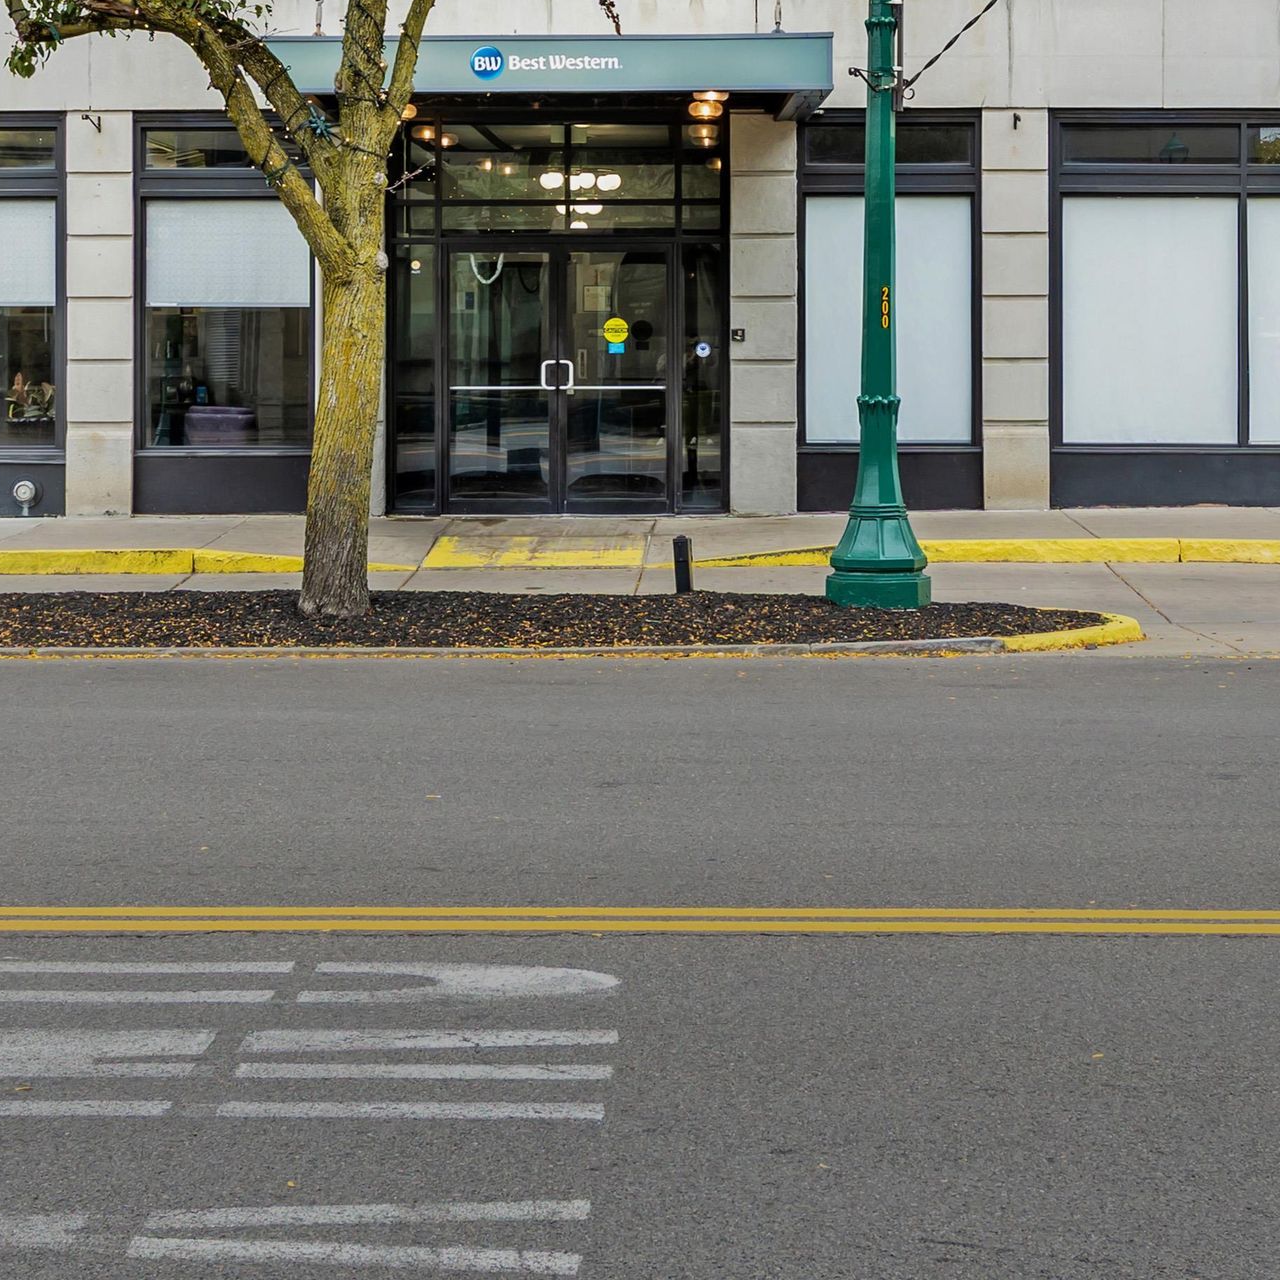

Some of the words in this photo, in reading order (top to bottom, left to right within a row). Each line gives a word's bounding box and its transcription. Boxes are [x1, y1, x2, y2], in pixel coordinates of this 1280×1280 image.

[474, 56, 502, 71] BW
[508, 55, 547, 70] Best
[548, 54, 619, 70] Western
[881, 286, 889, 329] 200
